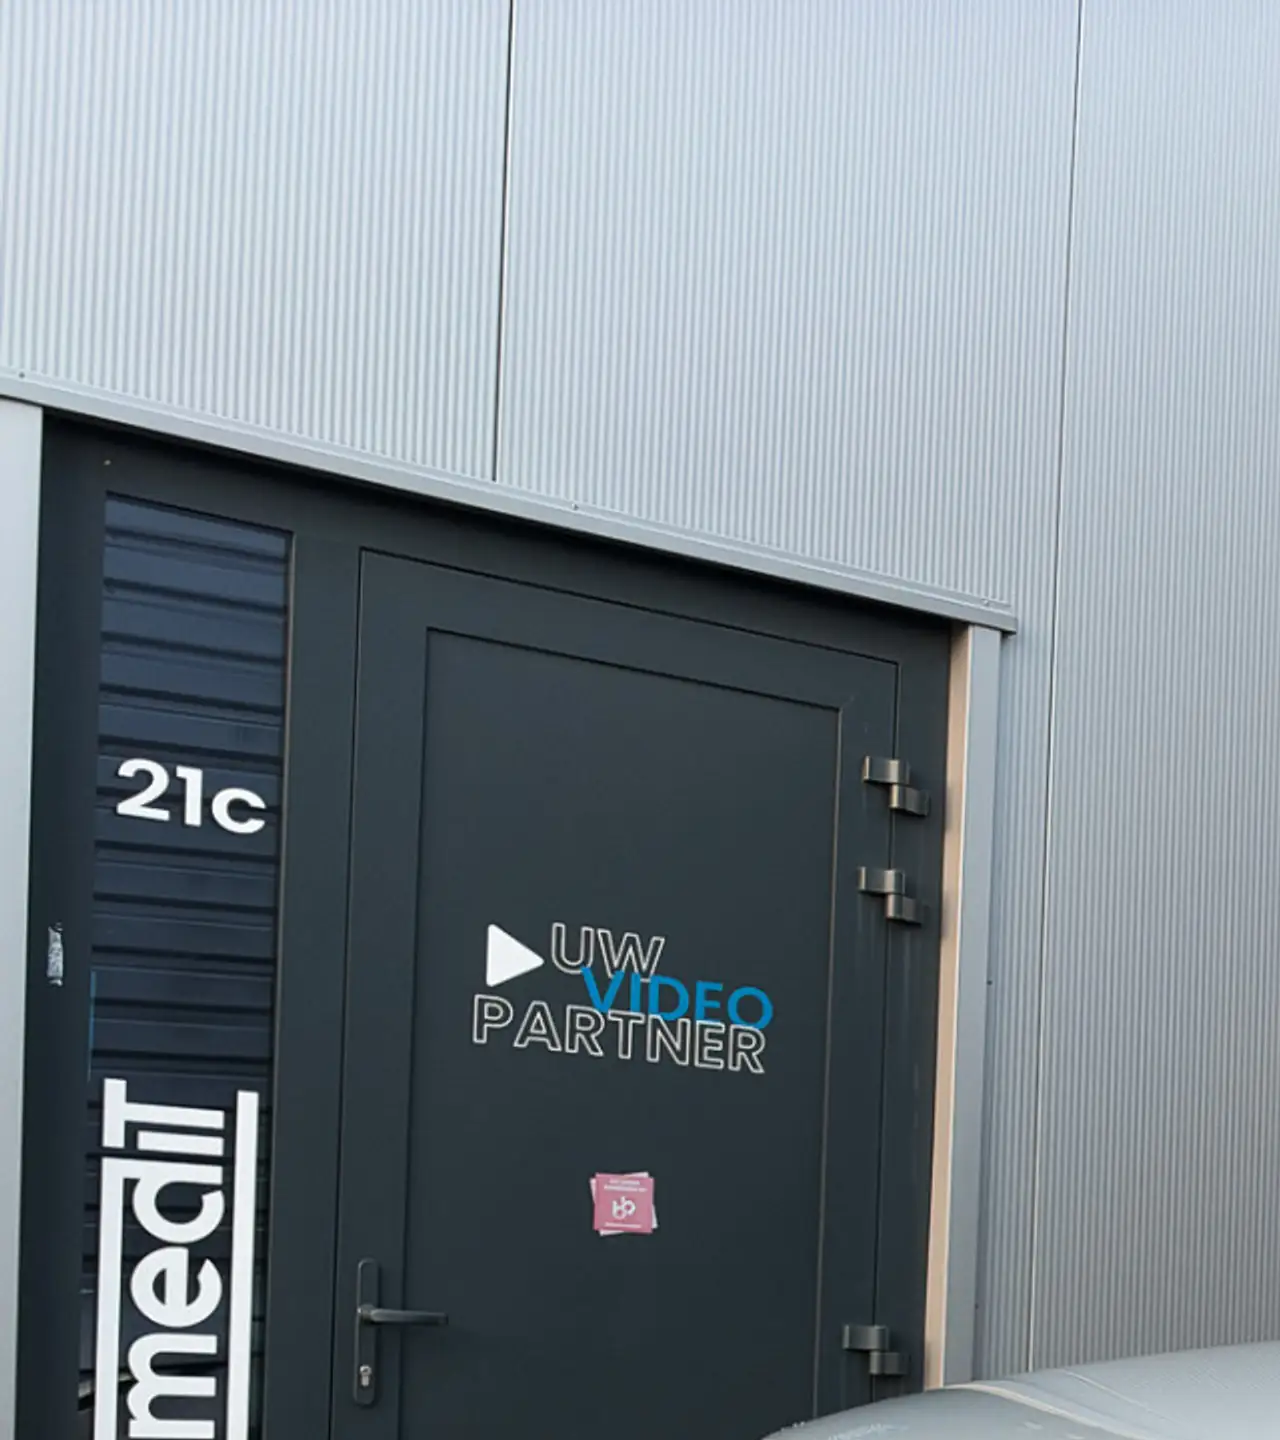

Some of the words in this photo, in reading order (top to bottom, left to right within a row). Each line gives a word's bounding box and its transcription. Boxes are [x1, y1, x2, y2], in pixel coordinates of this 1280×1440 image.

[116, 758, 266, 834] 21c
[551, 922, 665, 982] UW
[581, 966, 773, 1030] VIDEO
[472, 994, 766, 1074] PARTNER
